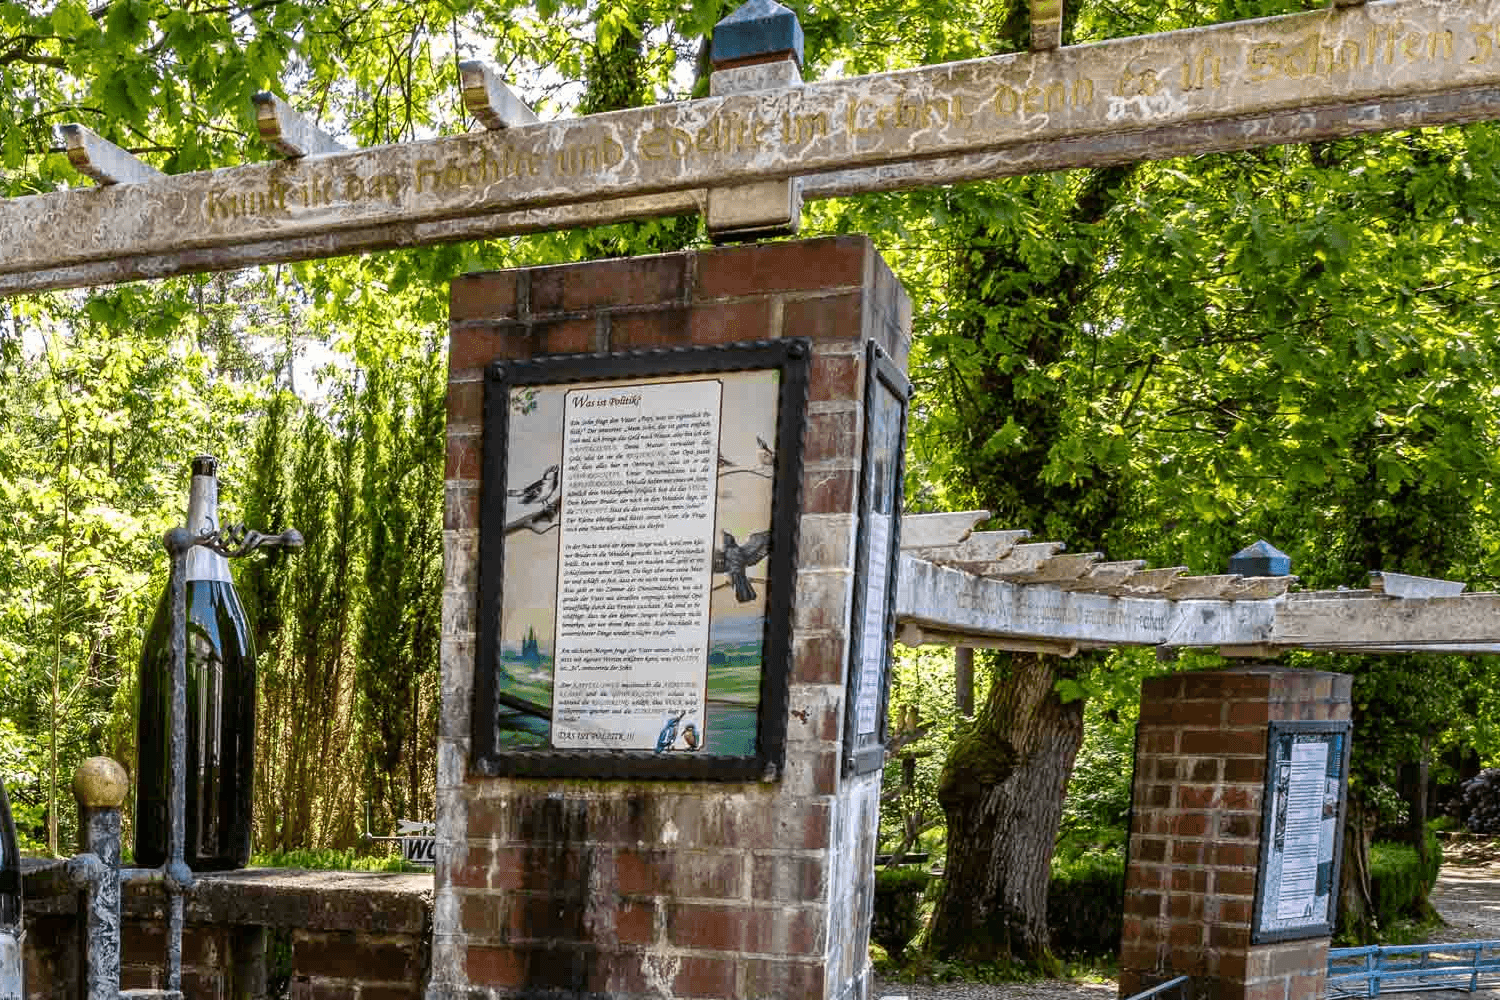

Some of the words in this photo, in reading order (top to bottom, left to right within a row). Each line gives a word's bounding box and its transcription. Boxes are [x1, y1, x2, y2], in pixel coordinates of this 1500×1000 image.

[994, 77, 1094, 116] denn
[1180, 53, 1222, 90] ist
[573, 395, 595, 408] Was
